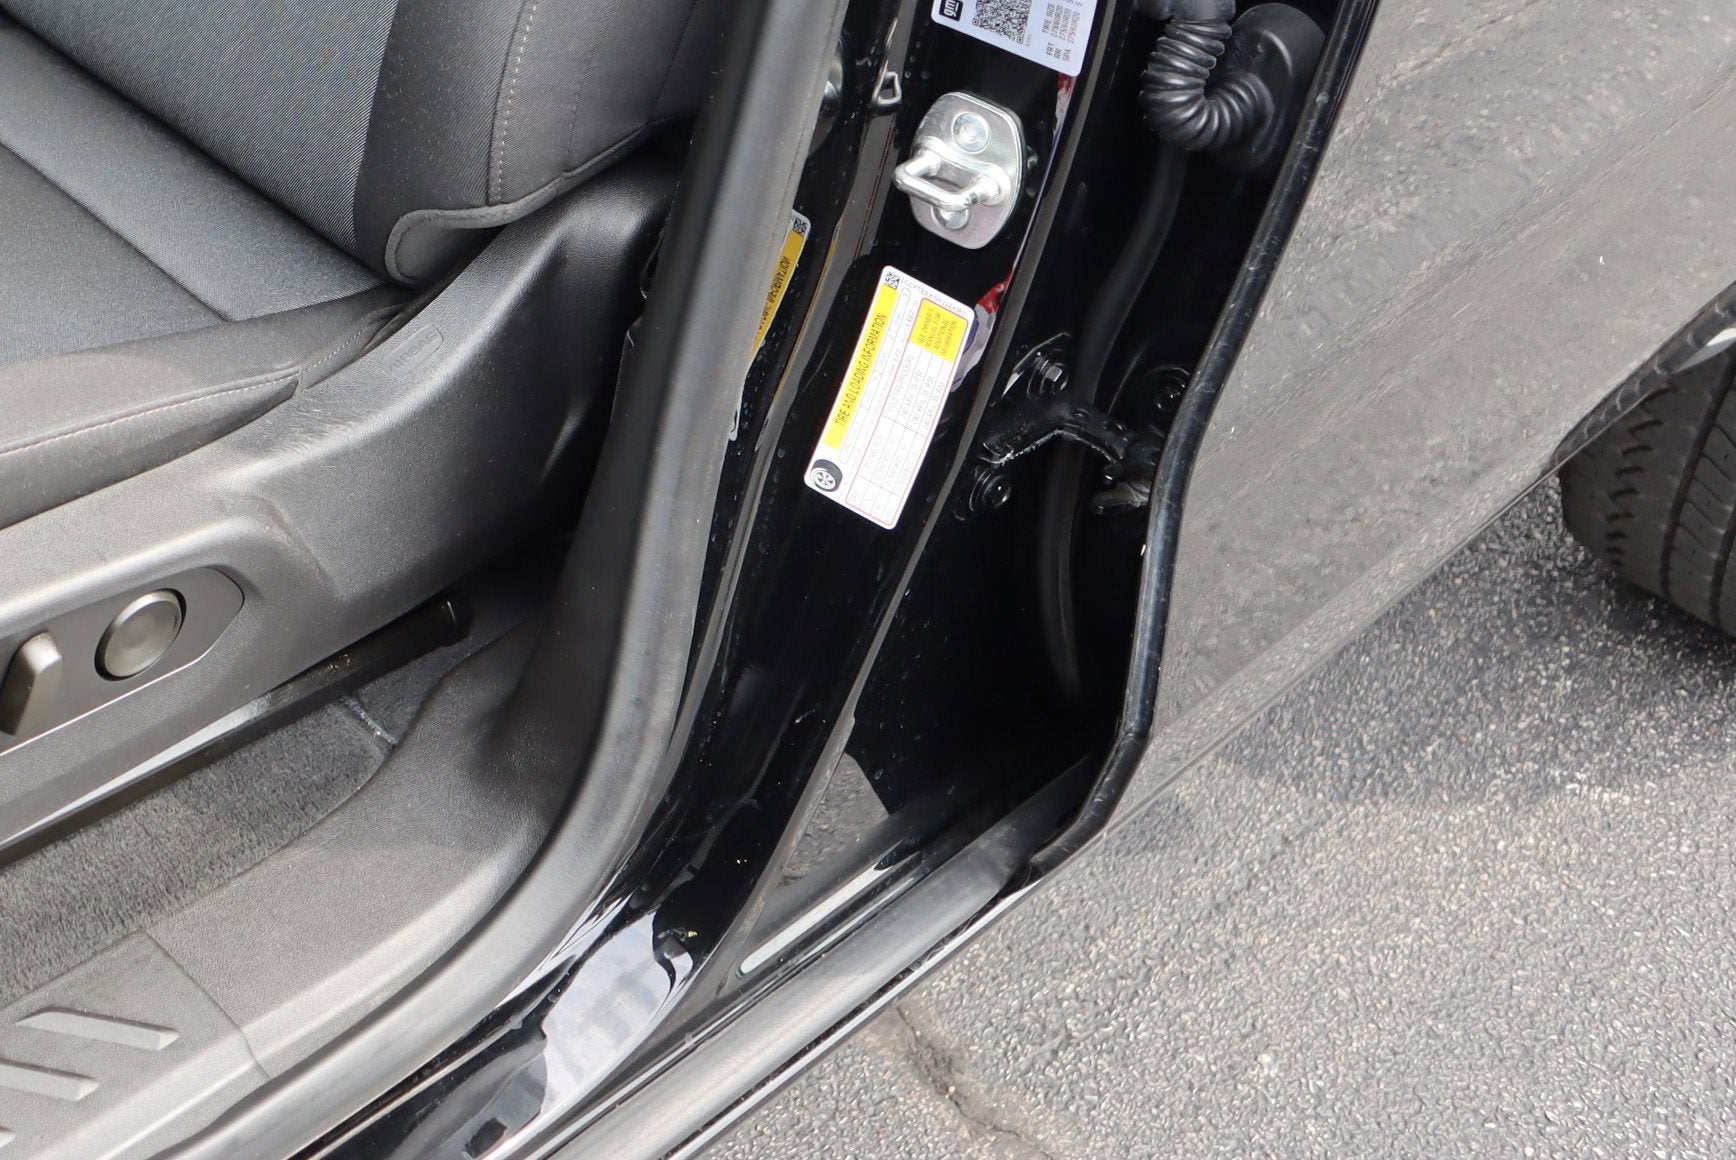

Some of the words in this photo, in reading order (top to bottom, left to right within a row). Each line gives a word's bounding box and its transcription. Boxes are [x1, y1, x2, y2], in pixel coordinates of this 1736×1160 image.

[389, 331, 438, 373] AIRBAG
[859, 311, 887, 362] INFORMATION
[938, 318, 958, 357] INFORMATION
[847, 358, 869, 395] LOADING
[834, 406, 850, 427] TIRE
[841, 392, 856, 410] AND
